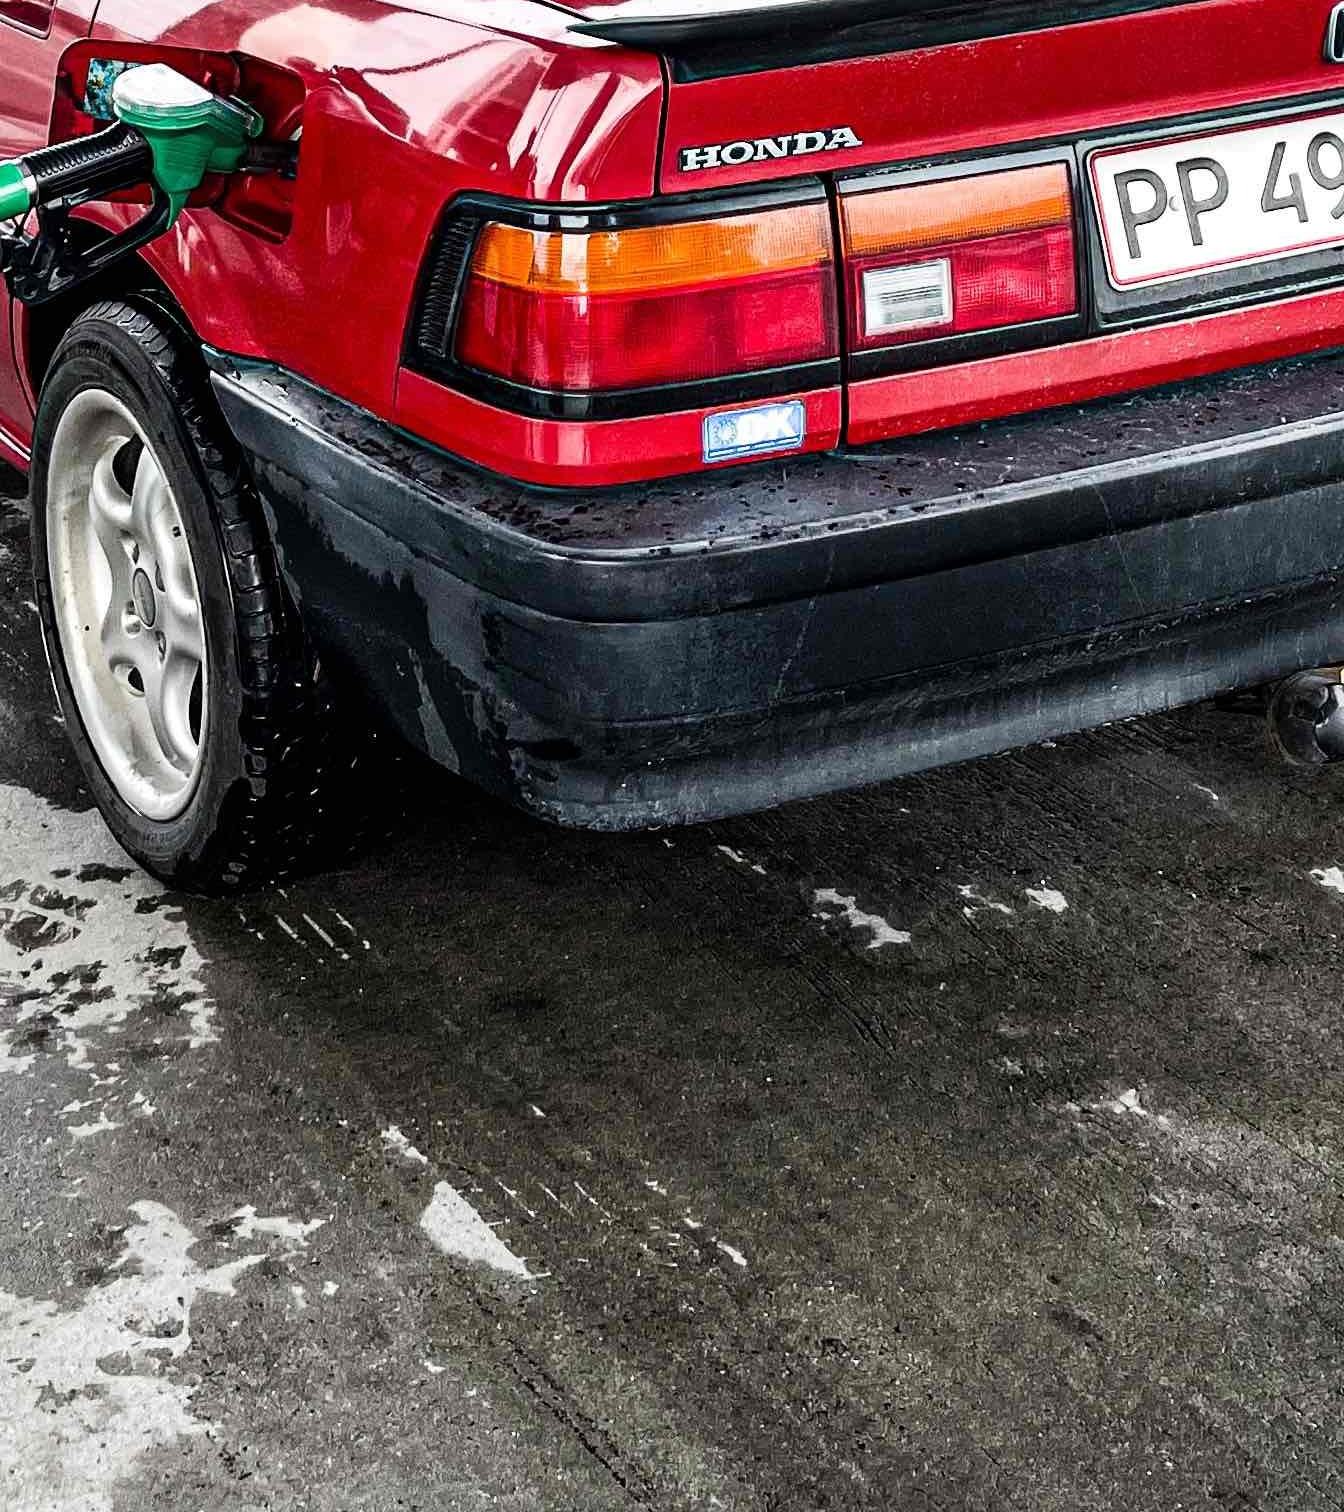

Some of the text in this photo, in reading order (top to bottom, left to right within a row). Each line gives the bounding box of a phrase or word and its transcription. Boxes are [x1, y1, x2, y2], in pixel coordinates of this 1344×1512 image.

[682, 126, 863, 172] HONDA
[1113, 156, 1229, 259] PP
[736, 407, 795, 442] DK
